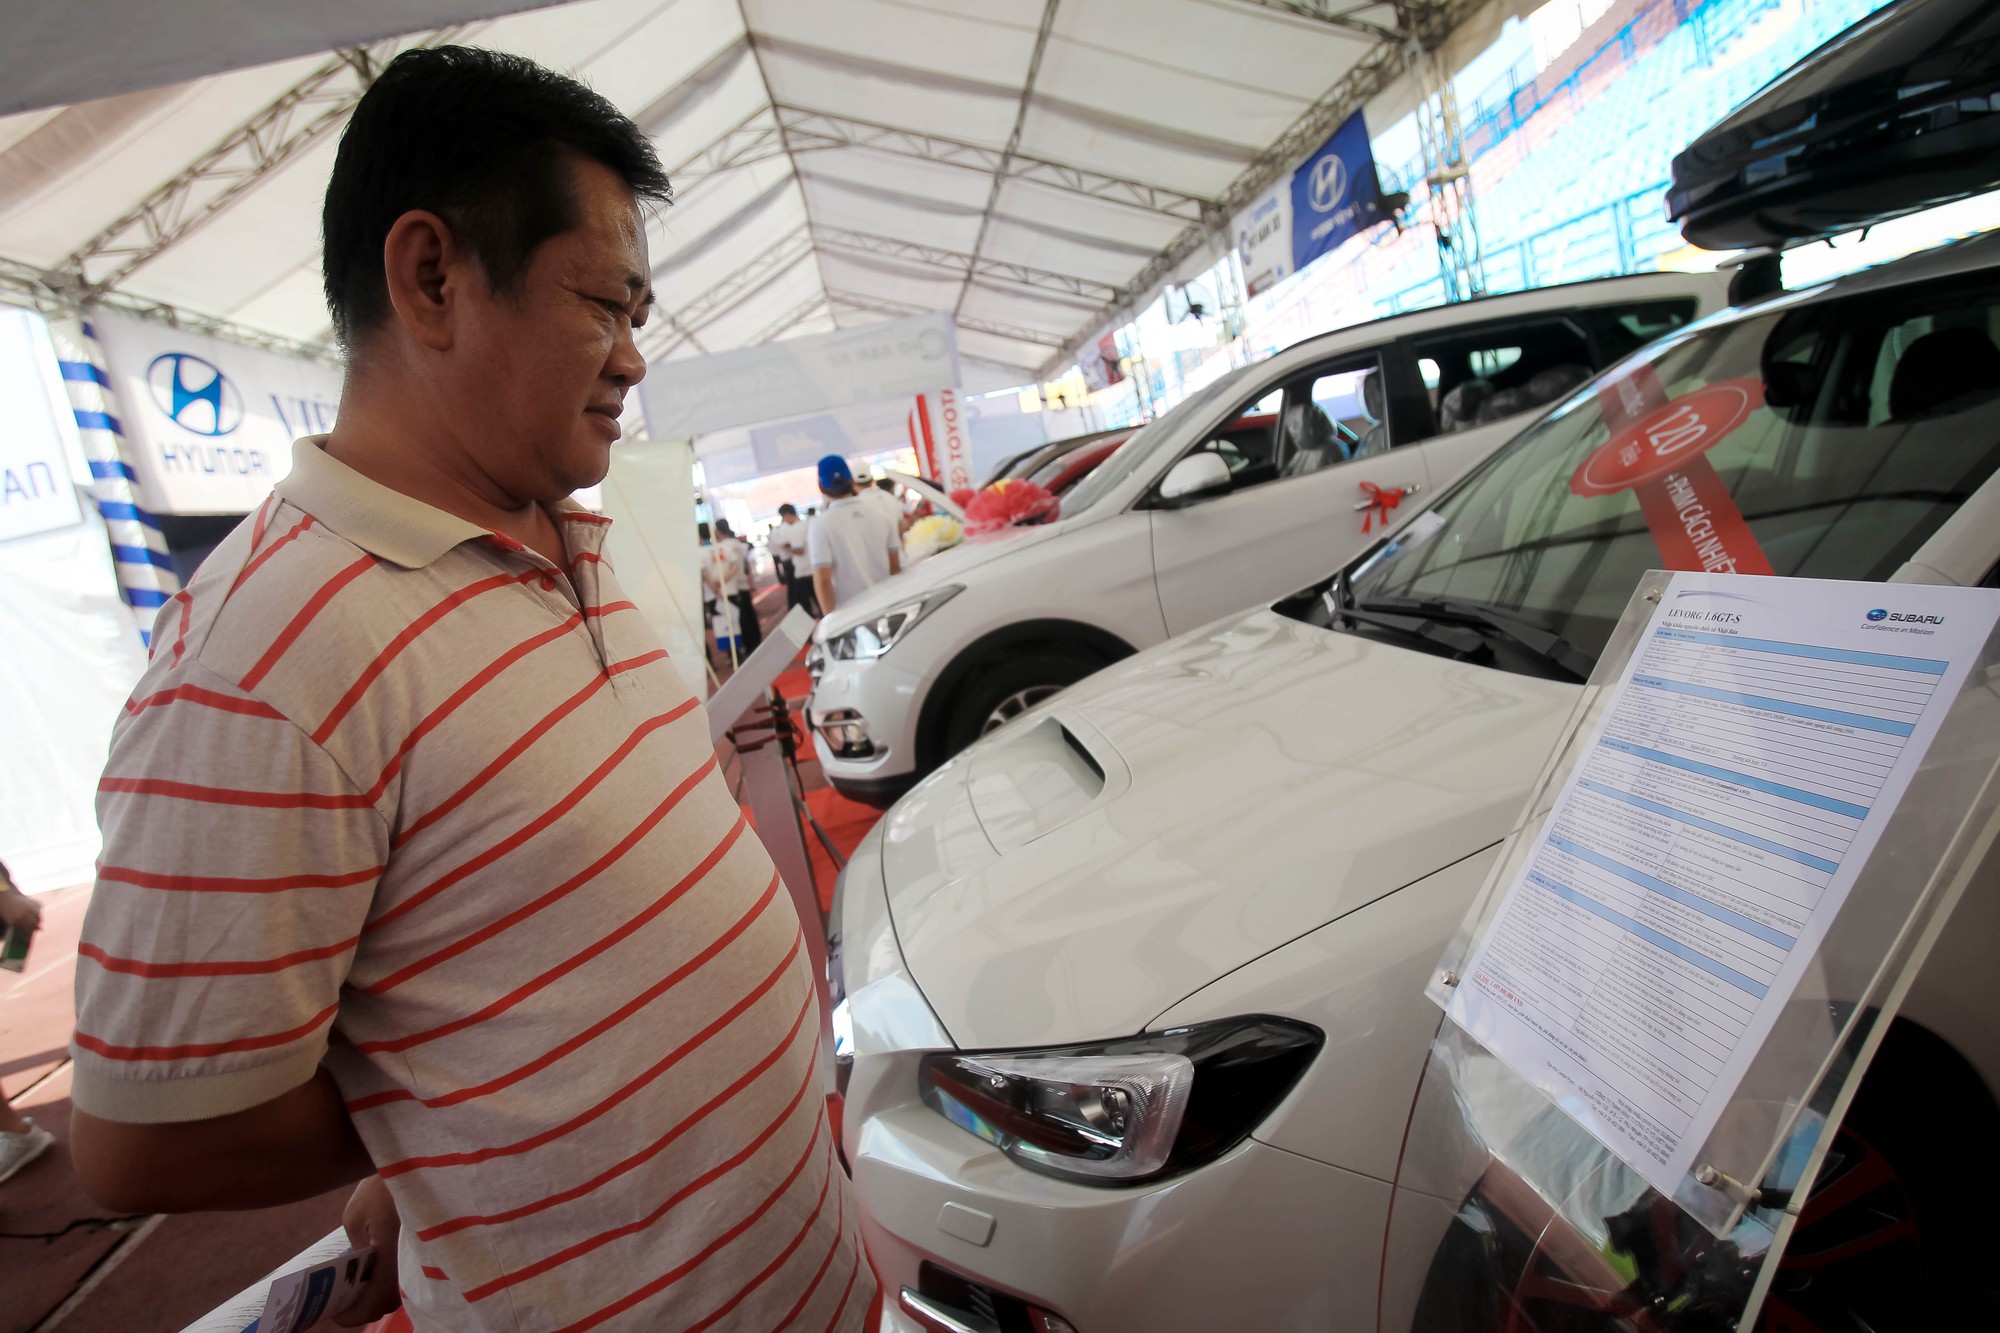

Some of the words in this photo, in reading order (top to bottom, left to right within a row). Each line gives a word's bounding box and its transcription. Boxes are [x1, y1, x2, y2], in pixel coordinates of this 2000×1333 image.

[1645, 405, 1707, 456] 120
[1666, 476, 1698, 511] PHIM
[1668, 608, 1703, 620] LEVORG
[1704, 611, 1742, 624] 1.6GT-S
[1889, 612, 1944, 625] SUBARU
[1860, 623, 1900, 633] Confidence
[1908, 627, 1935, 636] Motion
